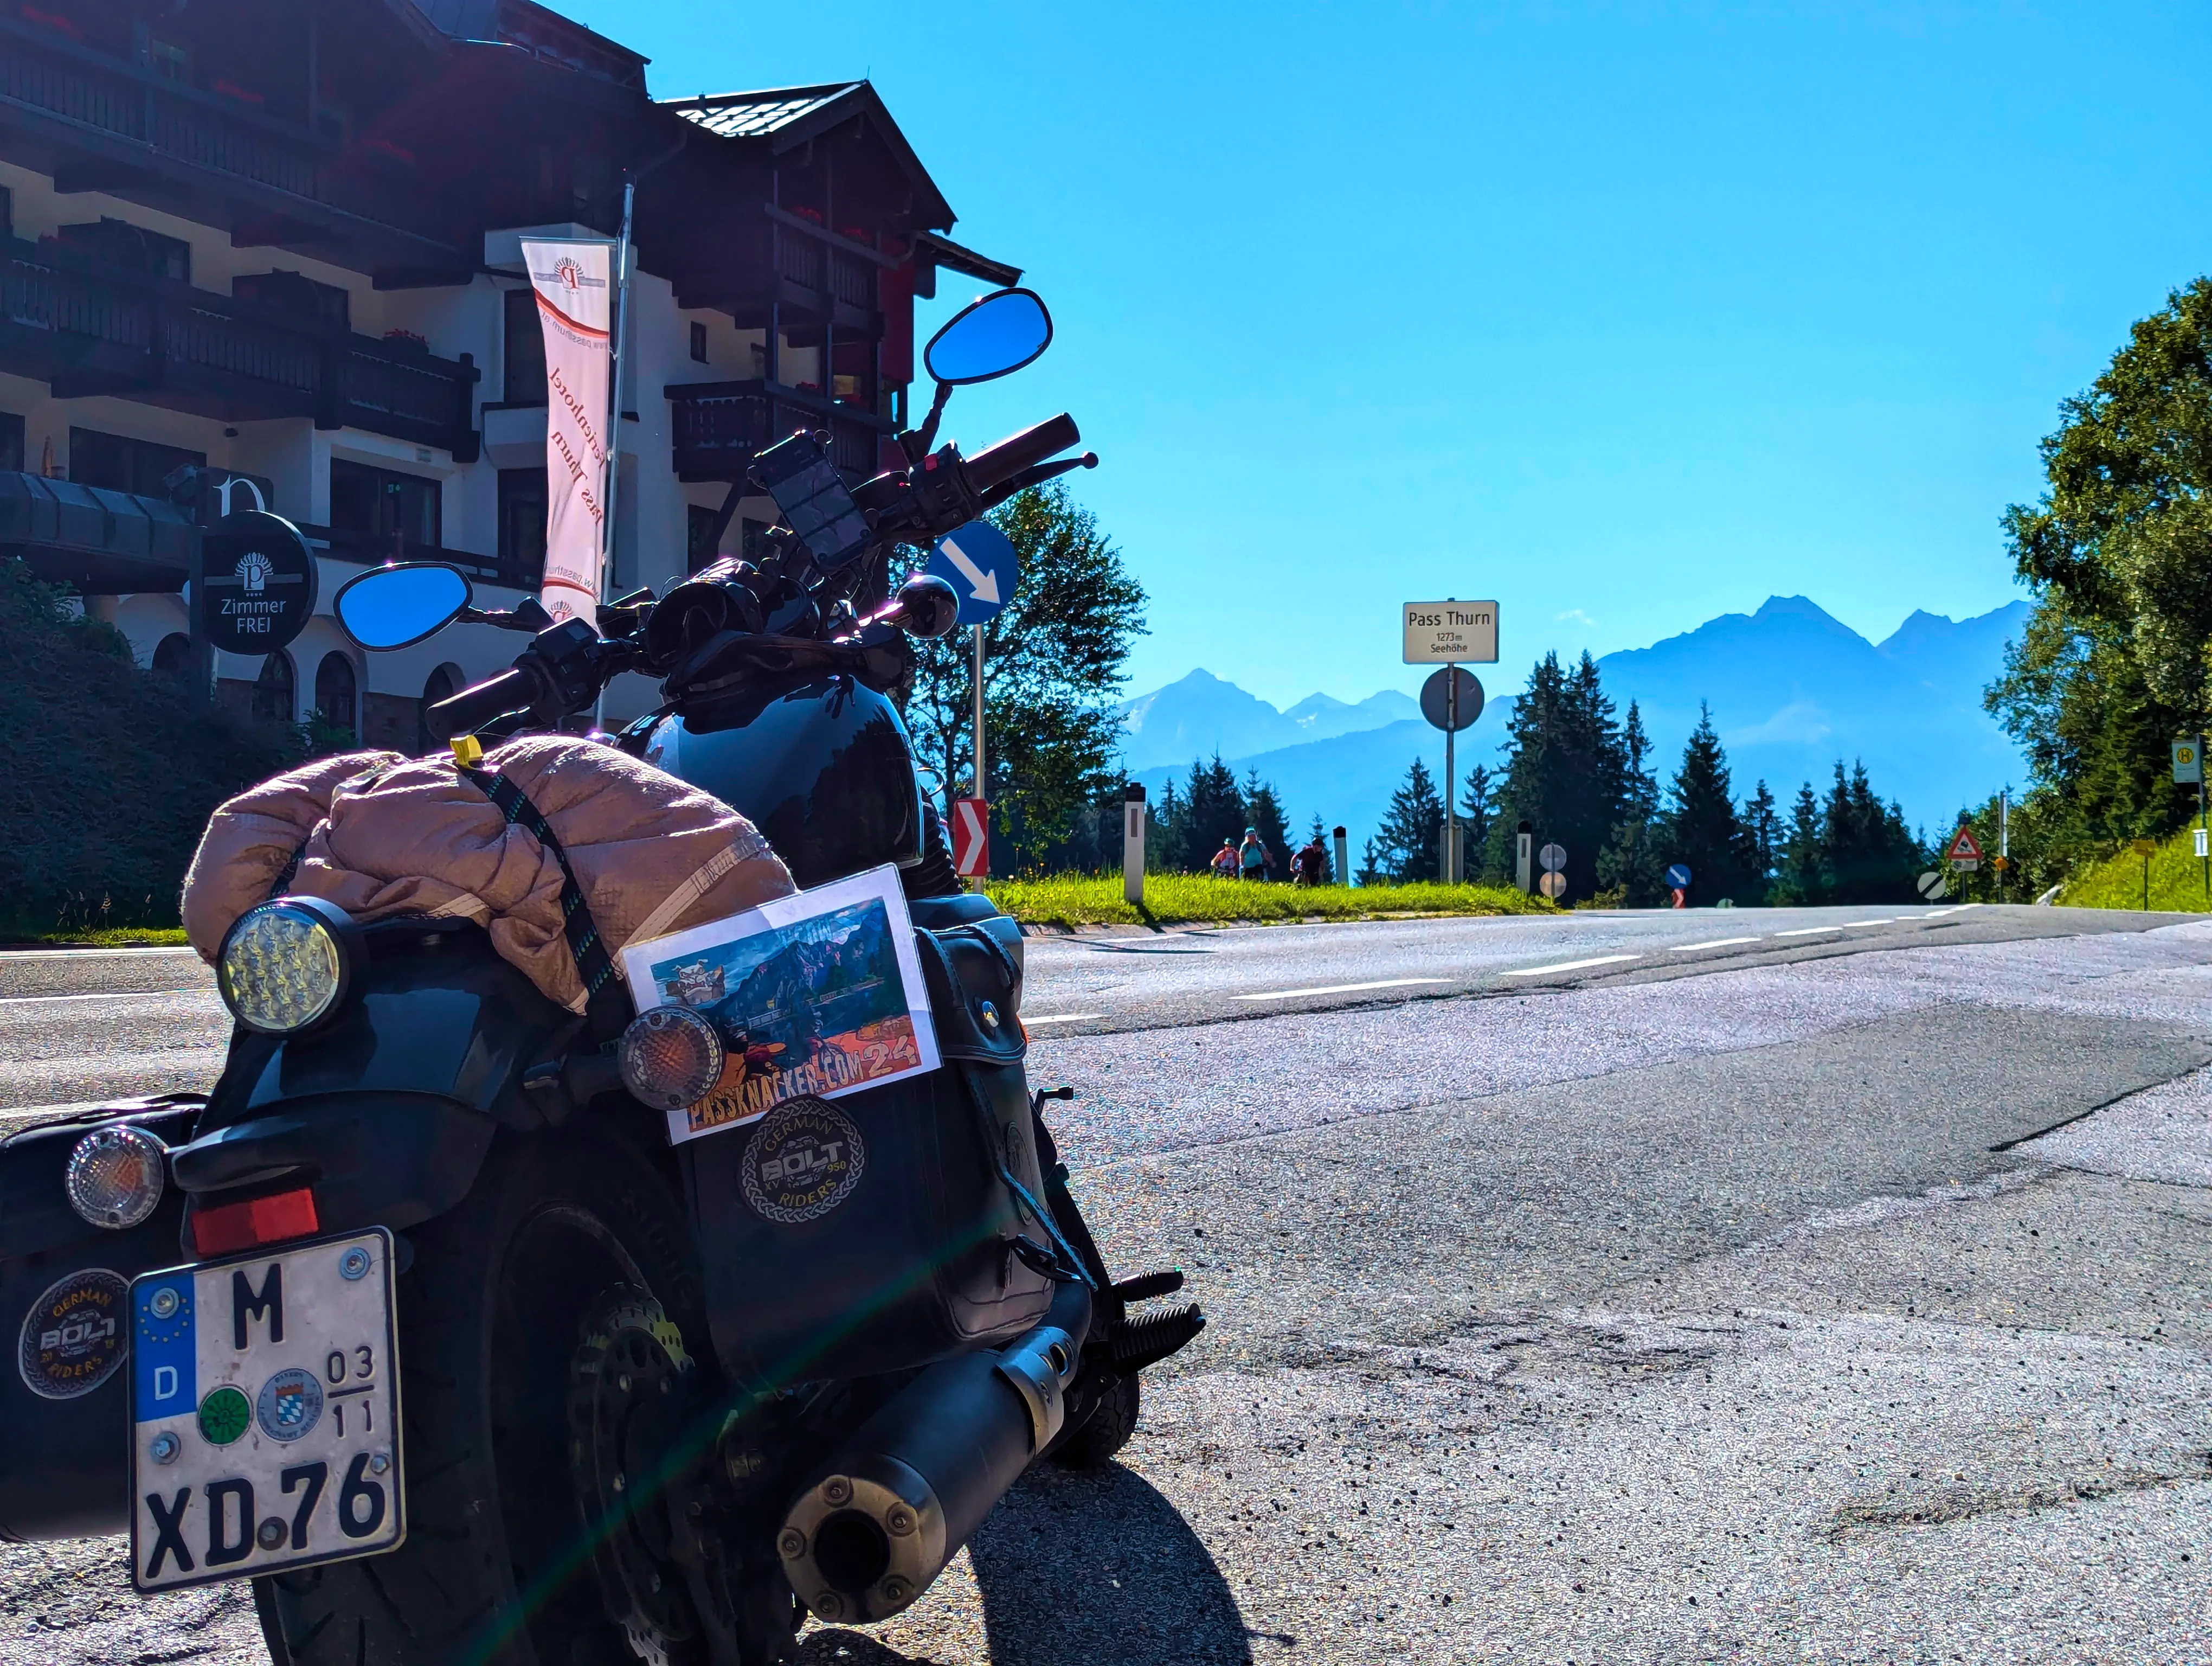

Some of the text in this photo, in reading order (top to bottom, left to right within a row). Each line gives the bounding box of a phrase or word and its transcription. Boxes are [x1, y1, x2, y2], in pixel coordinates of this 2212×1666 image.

[221, 598, 287, 614] Zimmer
[1409, 611, 1490, 627] Pass Thurn
[236, 617, 271, 633] FREI
[1430, 643, 1468, 653] Seehöhe
[765, 1116, 833, 1151] GERMAN
[761, 1141, 843, 1182] BOLT
[827, 1161, 846, 1174] 950
[779, 1179, 837, 1207] RIDERS
[53, 1288, 112, 1317] GERMAN
[232, 1263, 284, 1350] M
[40, 1317, 115, 1351] BOLT
[327, 1345, 374, 1385] 03
[154, 1365, 178, 1401] D
[333, 1399, 373, 1439] 11
[145, 1452, 386, 1579] XD 76
